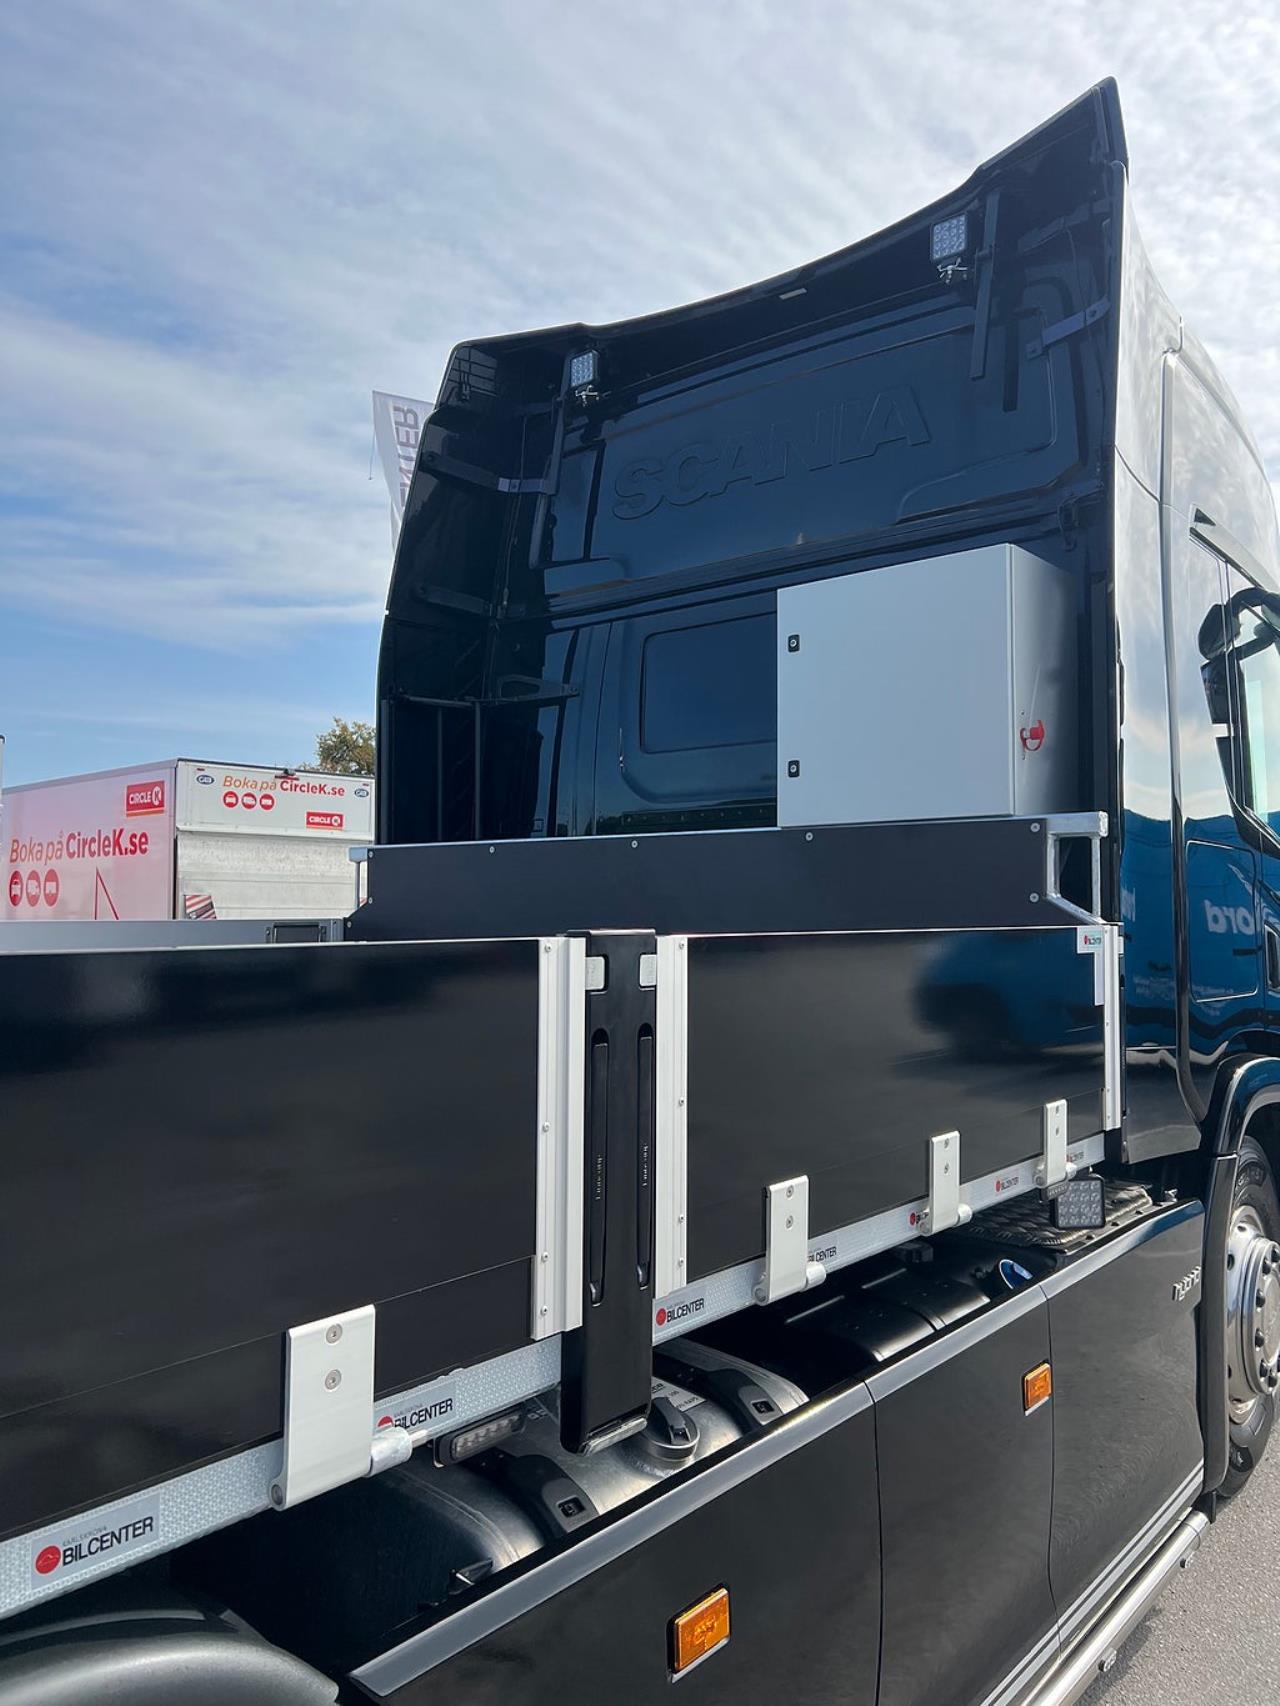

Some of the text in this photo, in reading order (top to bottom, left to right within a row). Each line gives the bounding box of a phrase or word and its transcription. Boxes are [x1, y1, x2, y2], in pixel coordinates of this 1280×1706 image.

[612, 384, 931, 520] SCANIA
[129, 792, 152, 804] CIRCLE
[223, 775, 257, 788] Boka
[280, 780, 345, 797] CircleK.se
[309, 815, 332, 824] CIRCLE
[10, 828, 149, 866] Boka på CircleK.se
[667, 1298, 705, 1323] BILCENTER
[62, 1516, 154, 1567] BILCENTER
